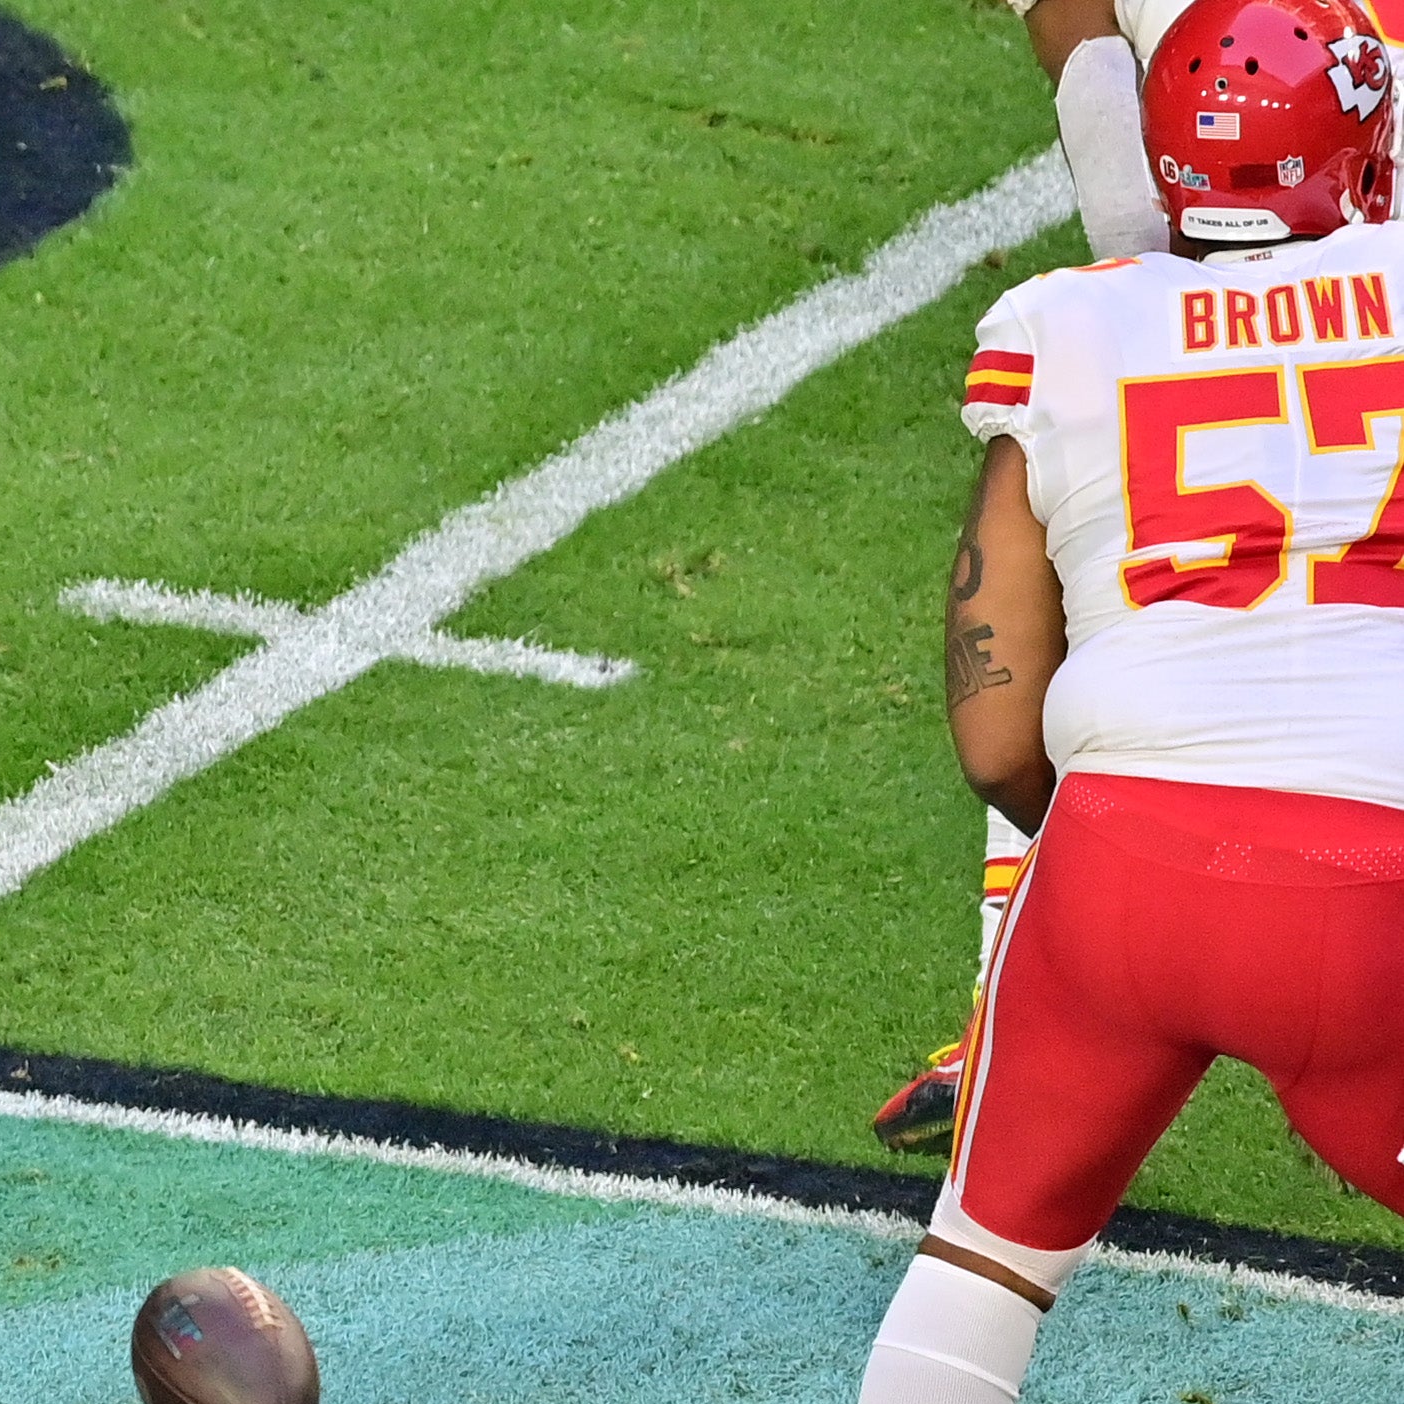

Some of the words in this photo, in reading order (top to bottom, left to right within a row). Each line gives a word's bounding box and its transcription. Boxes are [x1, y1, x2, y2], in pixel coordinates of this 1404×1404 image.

[1197, 217, 1223, 227] TAKES
[1225, 218, 1242, 228] ALL
[1243, 219, 1255, 227] OF
[1256, 218, 1269, 226] US
[1180, 272, 1394, 354] BROWN
